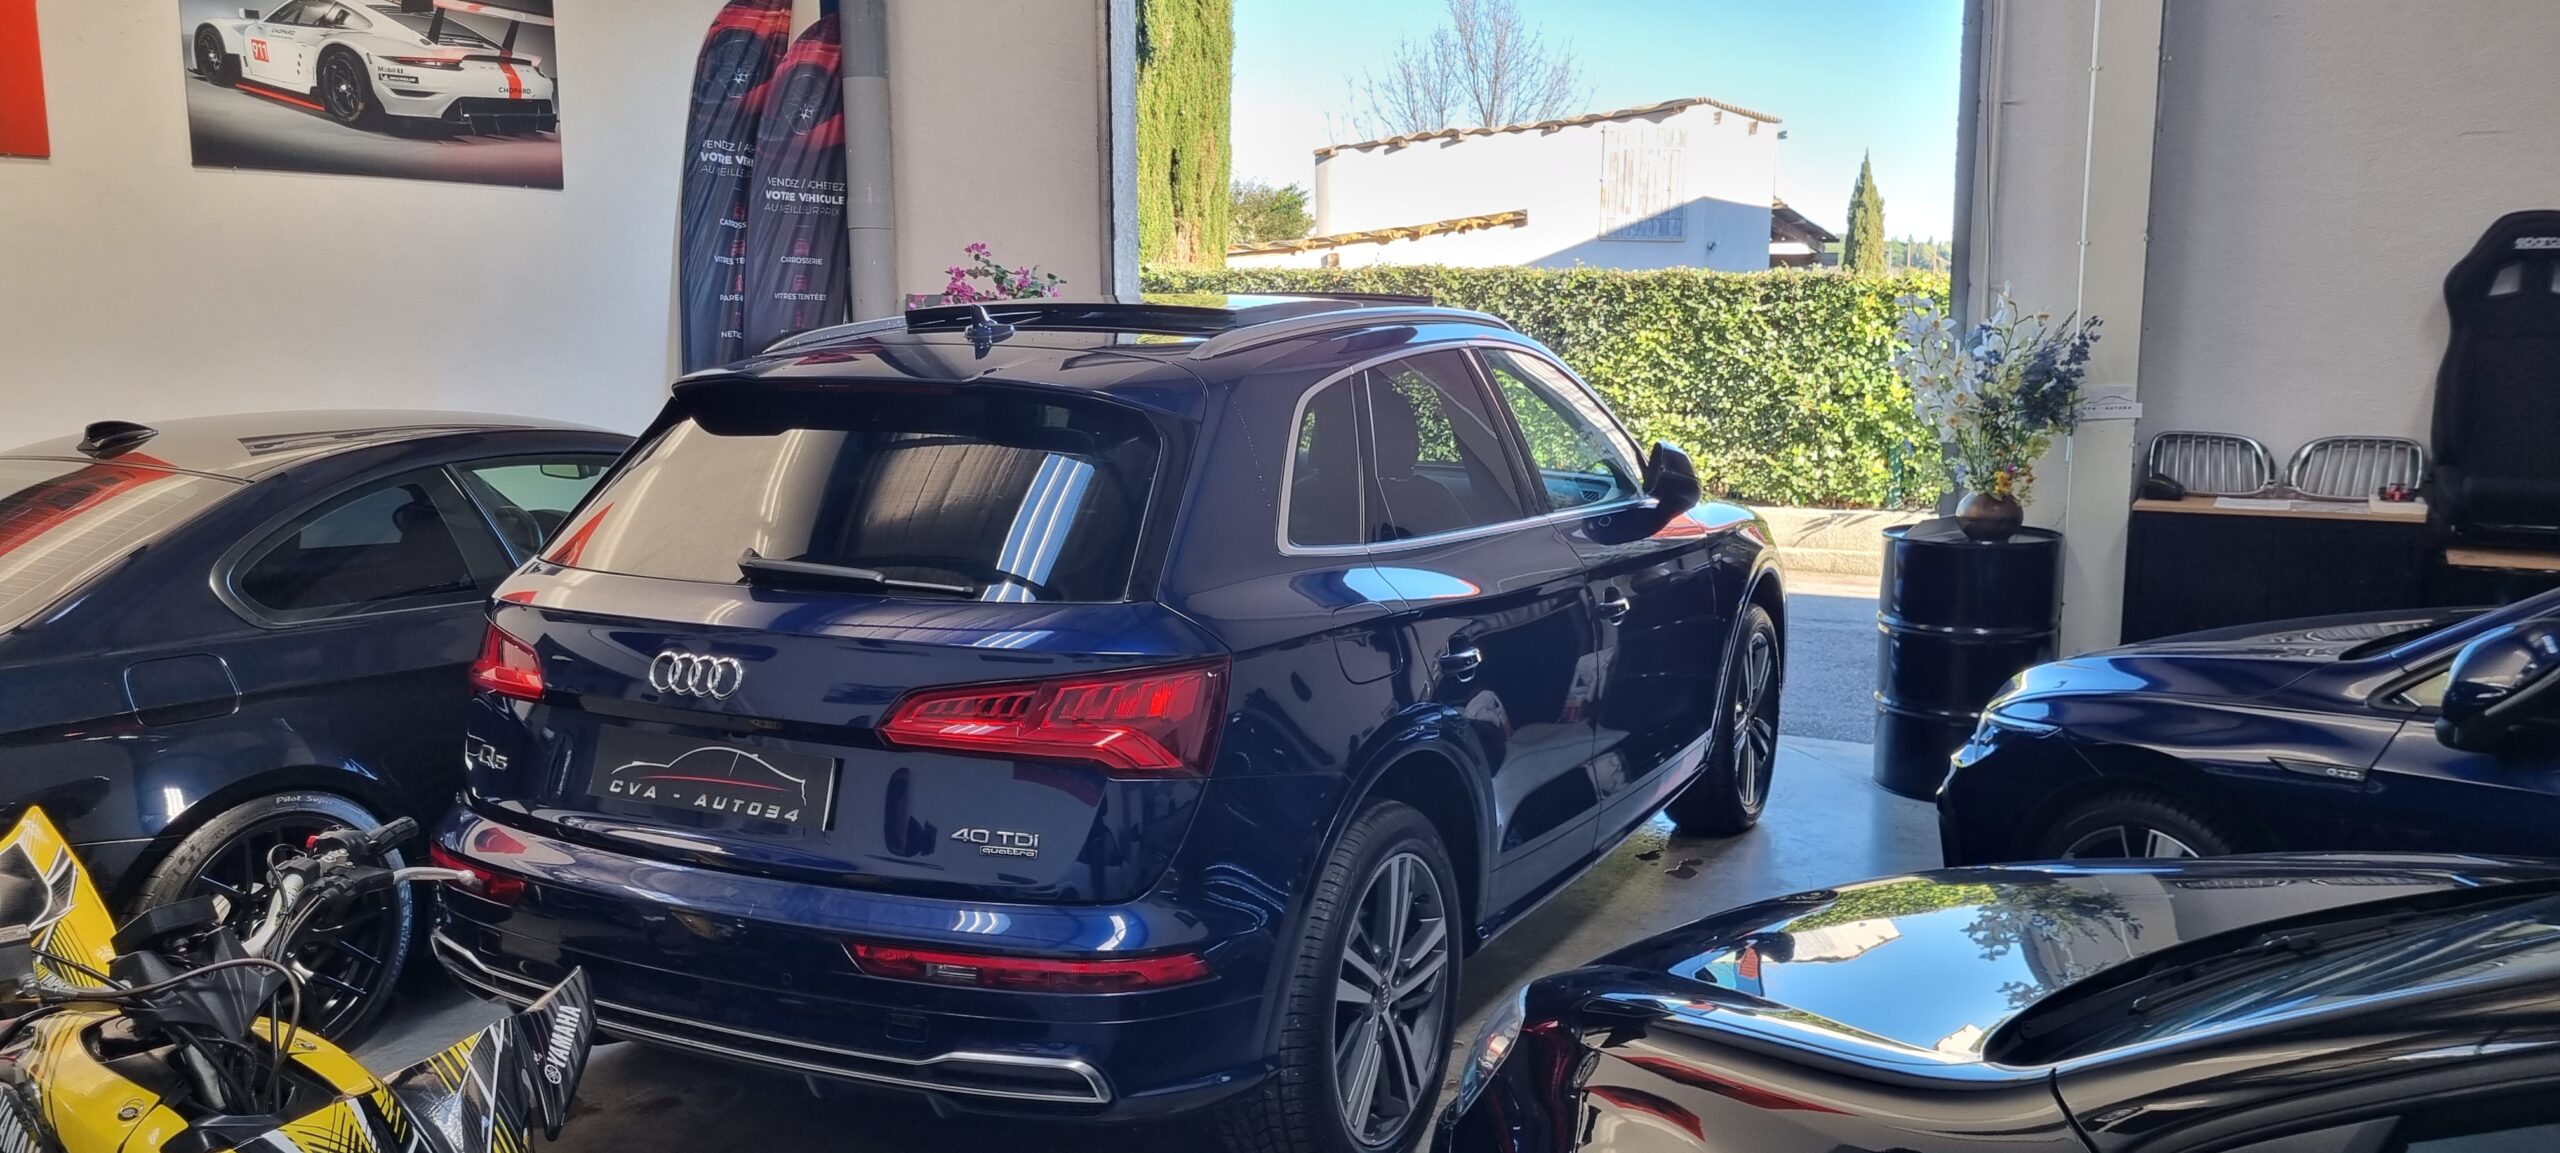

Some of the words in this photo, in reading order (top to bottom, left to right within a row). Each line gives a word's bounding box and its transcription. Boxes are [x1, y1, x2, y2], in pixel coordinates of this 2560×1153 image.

[252, 42, 268, 60] 911
[700, 151, 732, 164] VOTRE
[765, 190, 796, 201] VOTRE
[478, 744, 508, 770] Q5
[276, 795, 302, 804] Pilot
[610, 779, 657, 799] CVA
[694, 794, 800, 822] AUTO34
[951, 828, 989, 844] 40
[996, 831, 1039, 848] TDI
[982, 847, 1035, 857] quattro
[546, 1005, 582, 1069] YAMAHA
